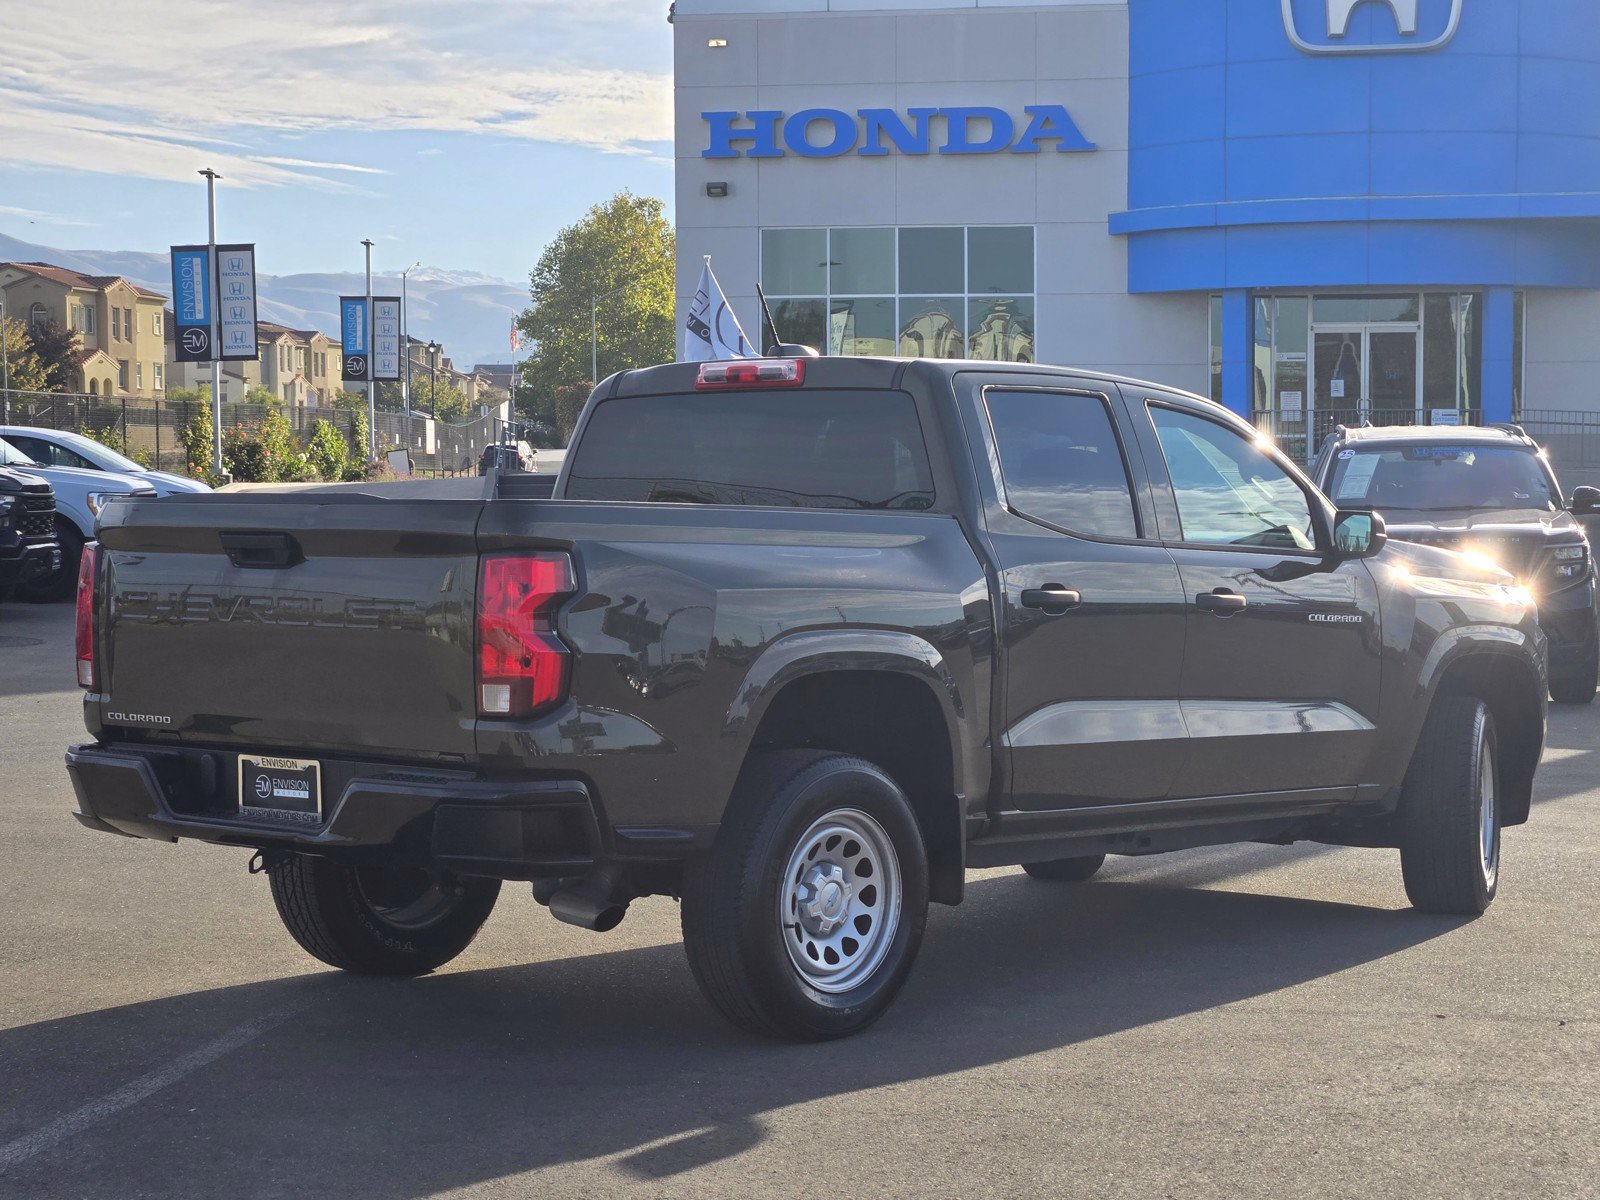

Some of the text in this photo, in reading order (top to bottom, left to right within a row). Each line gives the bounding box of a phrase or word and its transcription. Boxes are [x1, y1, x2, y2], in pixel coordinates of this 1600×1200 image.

[701, 104, 1098, 159] HONDA
[182, 257, 195, 320] ENVISION
[347, 304, 357, 351] ENVISION
[120, 591, 418, 630] CHEVROLET
[1308, 613, 1363, 623] COLORADO
[107, 711, 171, 724] COLORADO
[261, 757, 298, 769] ENVISION
[272, 778, 309, 790] ENVISION
